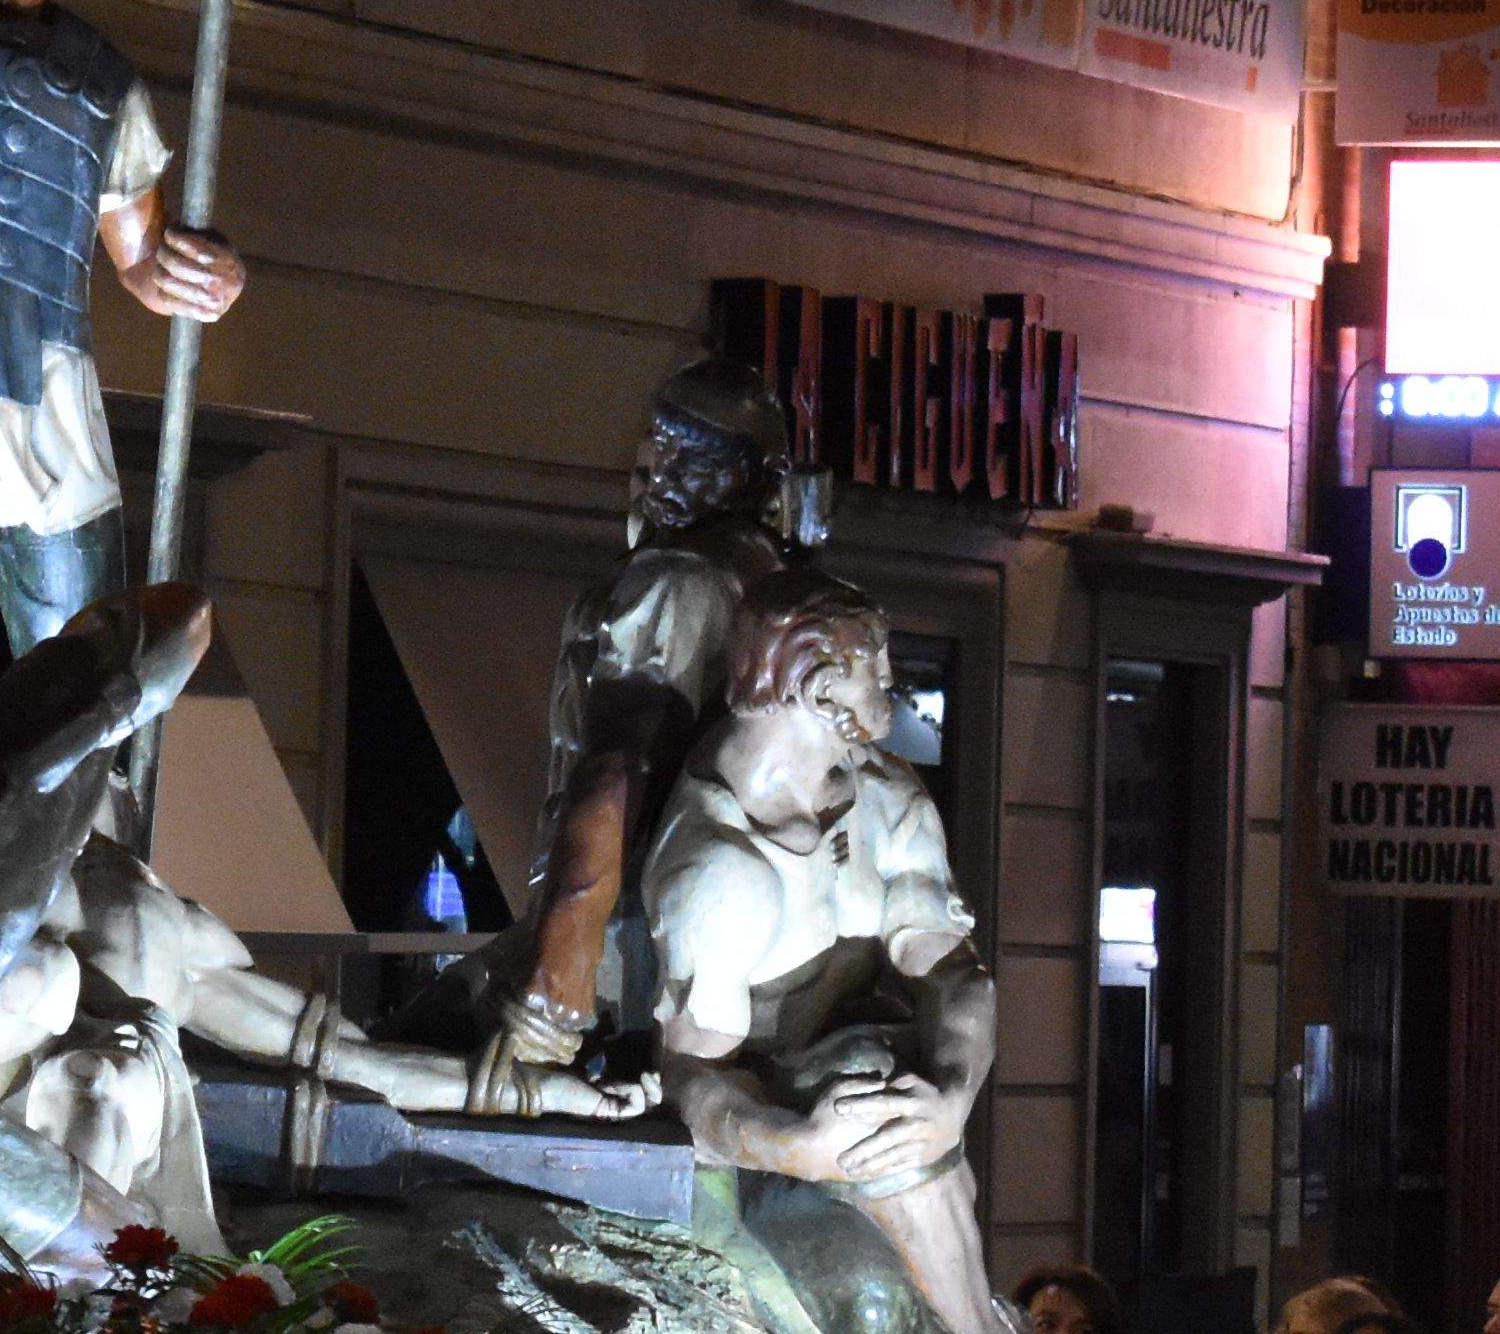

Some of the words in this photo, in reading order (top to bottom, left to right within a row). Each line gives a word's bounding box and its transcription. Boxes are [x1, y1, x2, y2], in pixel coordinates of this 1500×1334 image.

[1472, 586, 1485, 606] y
[1393, 604, 1479, 626] Apuestas
[1393, 625, 1459, 645] Estado
[1375, 723, 1454, 769] HAY
[1330, 780, 1497, 831] LOTERIA
[1327, 838, 1493, 885] NACIONAL
